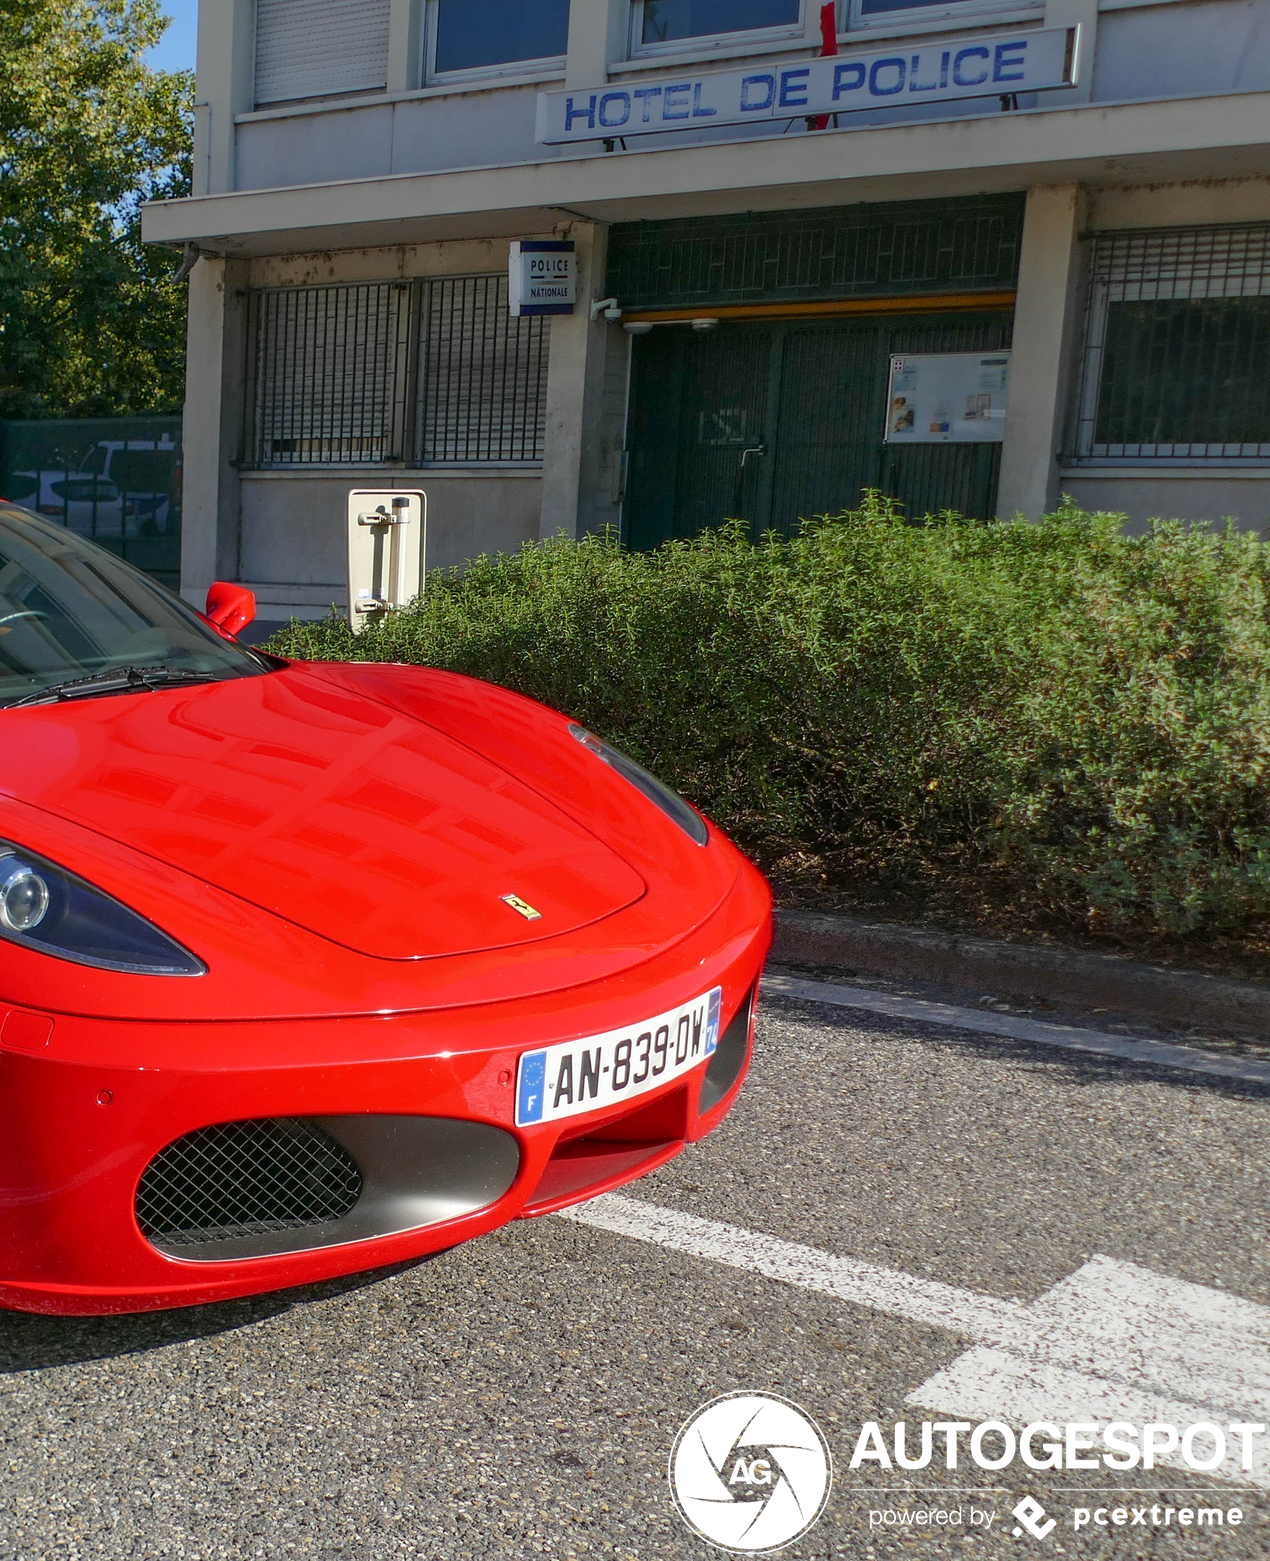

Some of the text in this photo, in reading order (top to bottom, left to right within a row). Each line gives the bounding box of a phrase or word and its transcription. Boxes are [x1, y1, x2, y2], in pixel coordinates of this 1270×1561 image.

[564, 40, 1029, 132] HOTEL DE POLICE
[531, 259, 568, 272] POLICE
[530, 287, 568, 298] NATIONALE
[706, 1021, 718, 1050] 74
[552, 1004, 705, 1109] AN-839-DW
[527, 1095, 537, 1112] F
